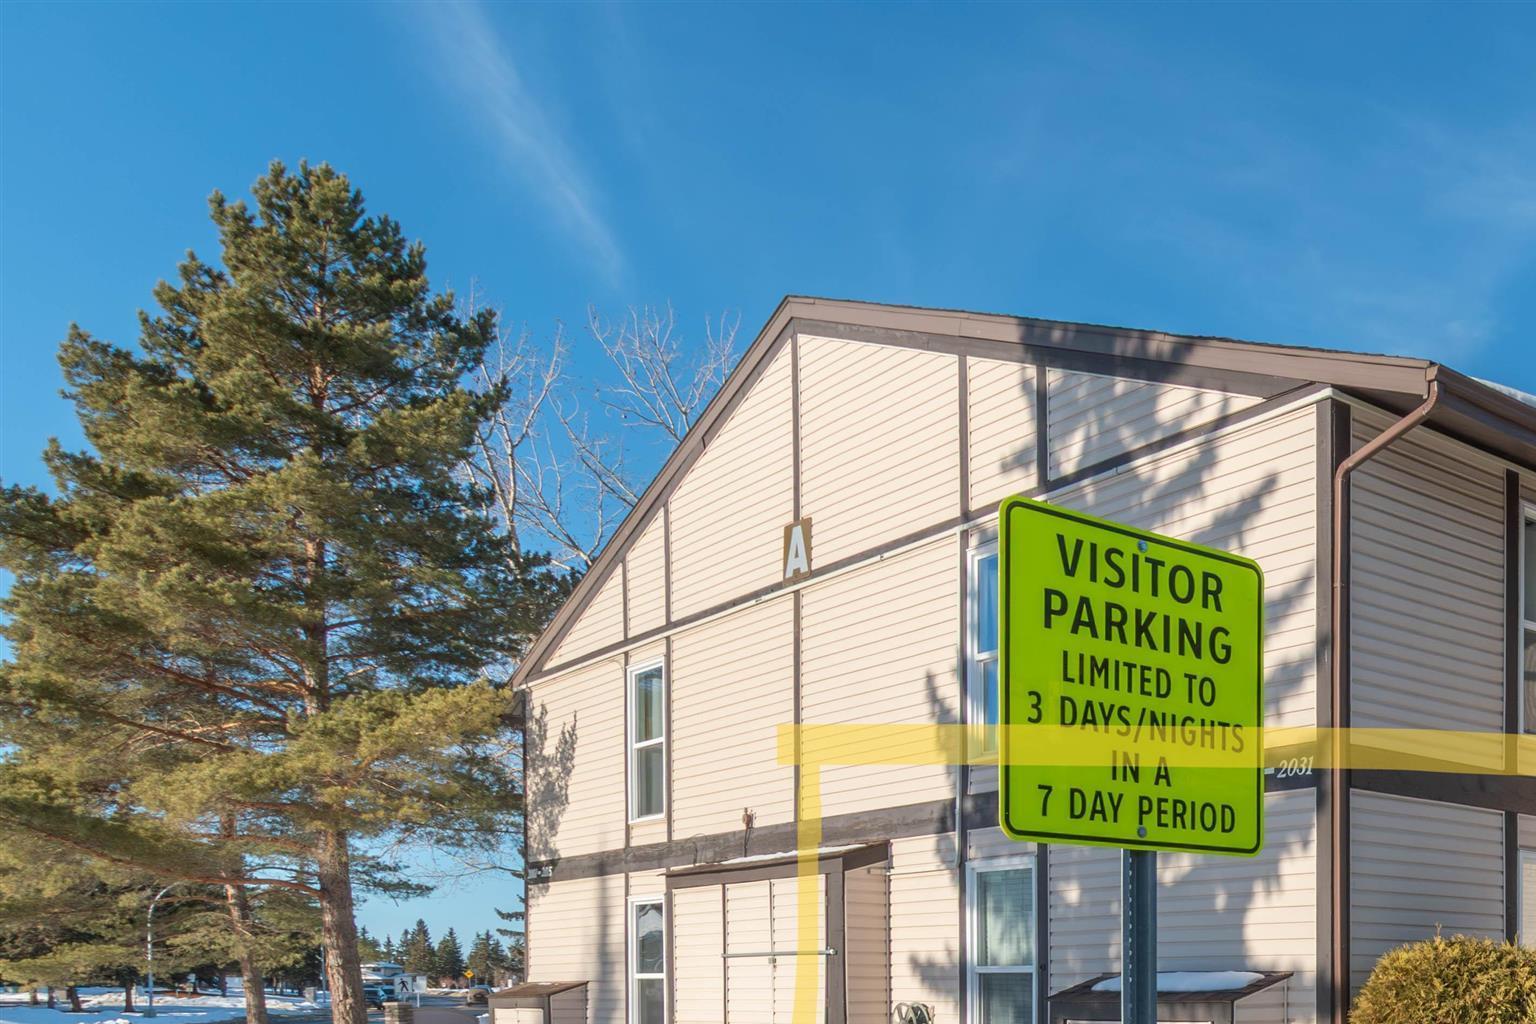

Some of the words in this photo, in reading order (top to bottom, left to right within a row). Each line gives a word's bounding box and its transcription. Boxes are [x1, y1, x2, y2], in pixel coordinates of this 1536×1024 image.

[785, 525, 809, 579] A
[1056, 533, 1223, 613] VISITOR
[1043, 588, 1233, 665] PARKING
[1062, 650, 1171, 700] LIMITED
[1184, 673, 1216, 708] TO
[1027, 691, 1043, 724] 3
[1060, 695, 1245, 753] DAYS/NIGHTS
[1111, 750, 1139, 784] IN
[1154, 756, 1172, 788] A
[1037, 784, 1053, 817] 7
[1069, 787, 1125, 823] DAY
[1138, 795, 1236, 834] PERIOD
